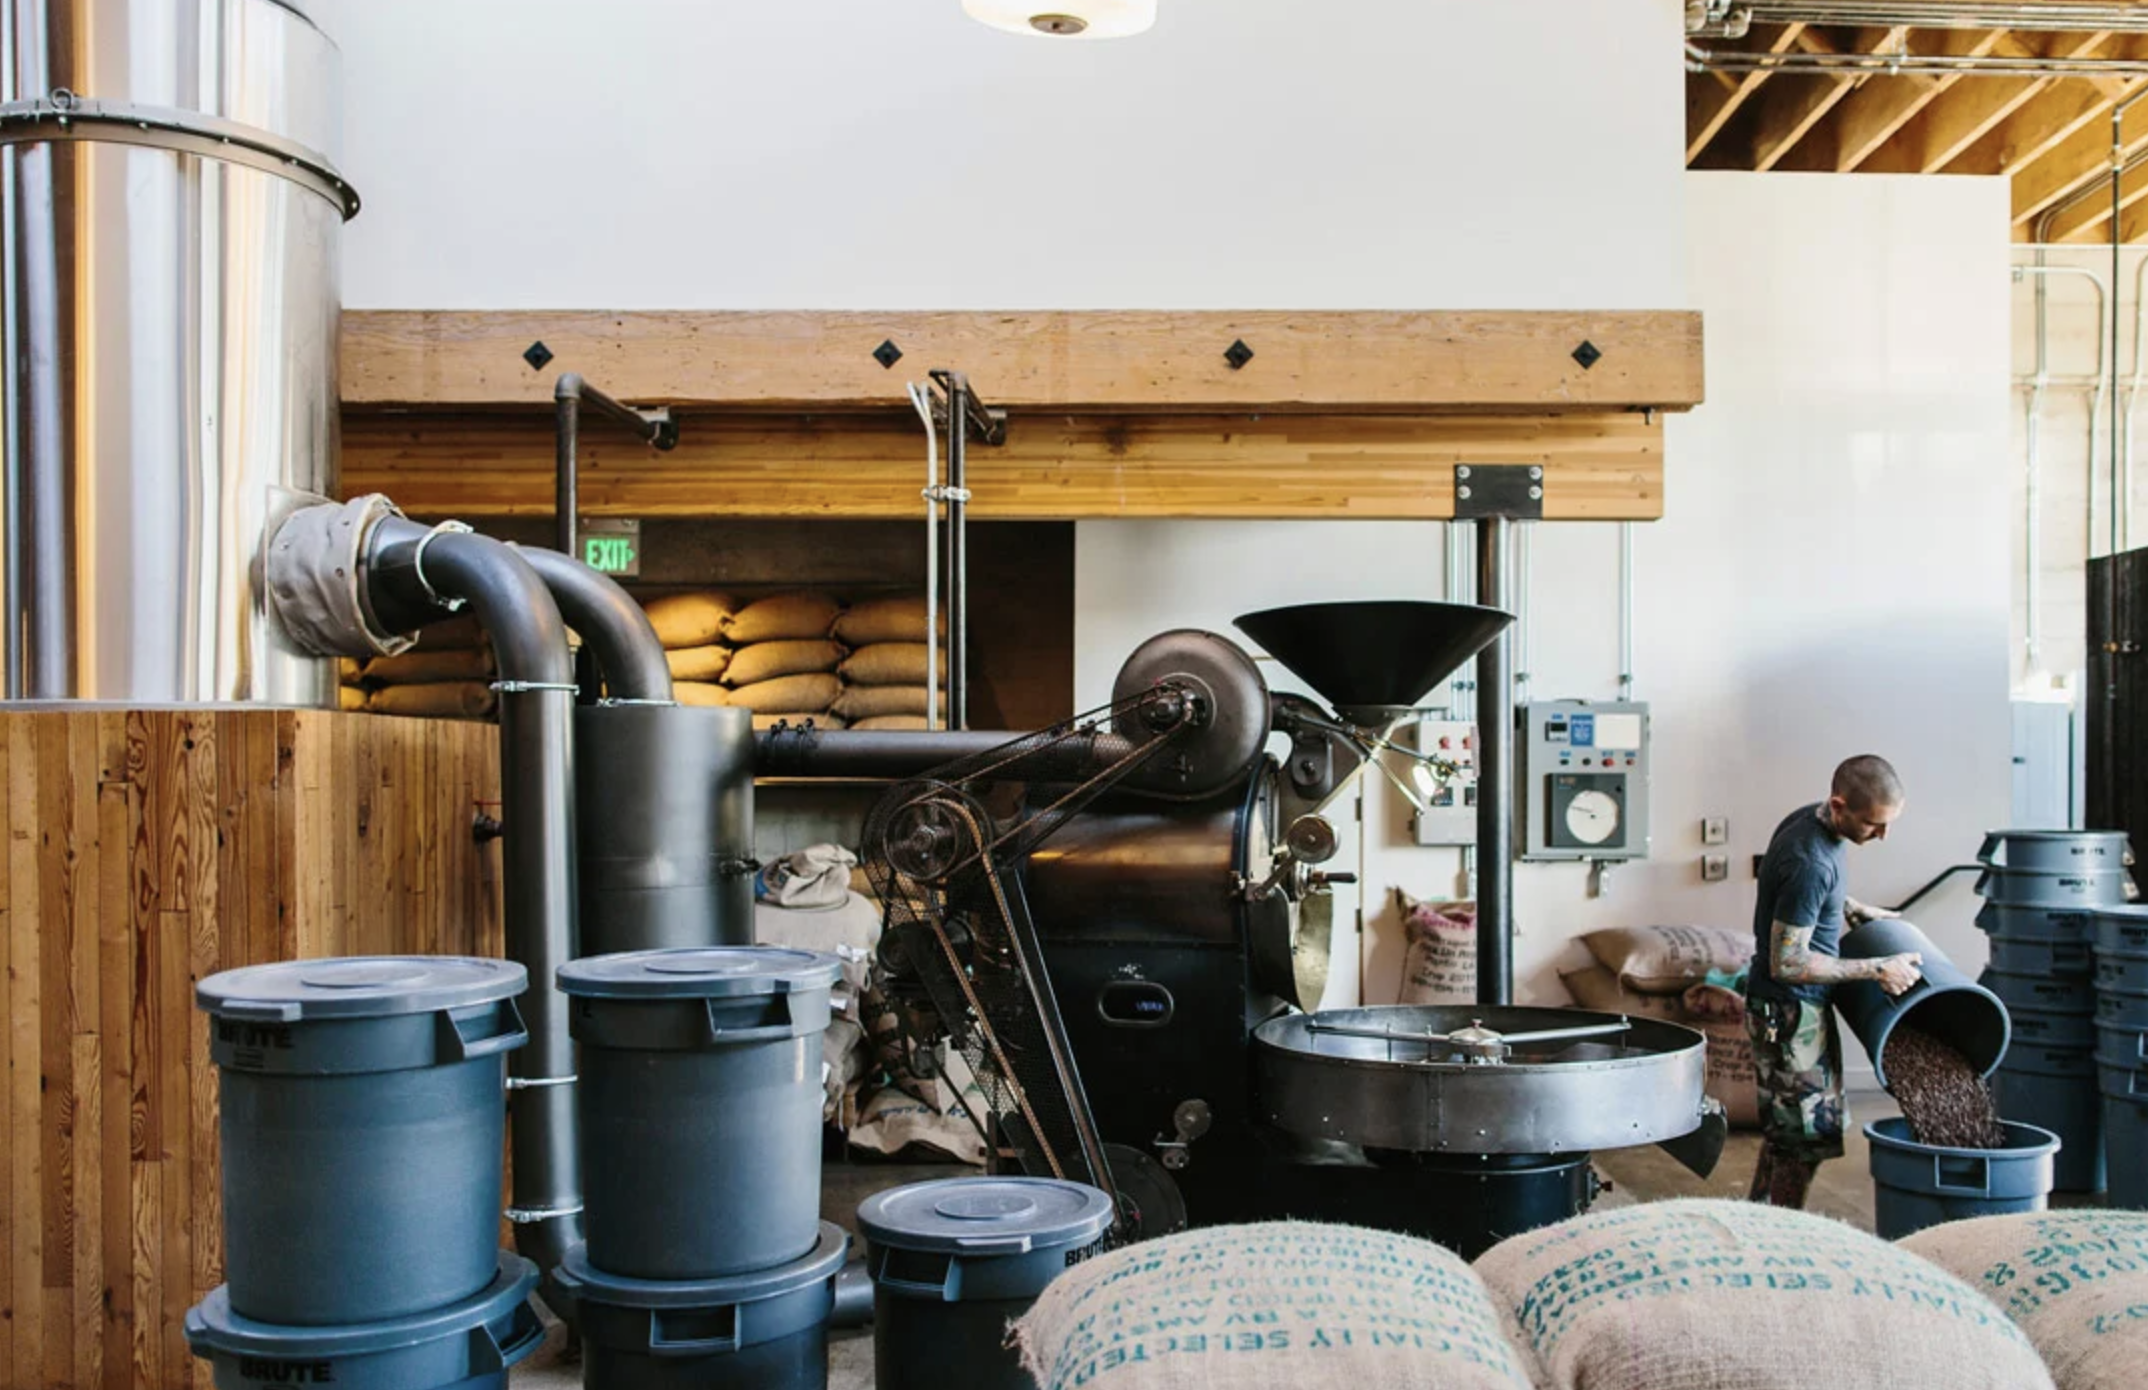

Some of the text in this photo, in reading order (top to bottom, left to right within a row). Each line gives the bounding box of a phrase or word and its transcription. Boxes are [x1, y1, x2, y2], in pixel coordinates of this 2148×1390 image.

[586, 538, 629, 571] EXIT
[240, 1356, 333, 1382] BRUTE
[1074, 1328, 1511, 1387] PECIALLY SELECTED
